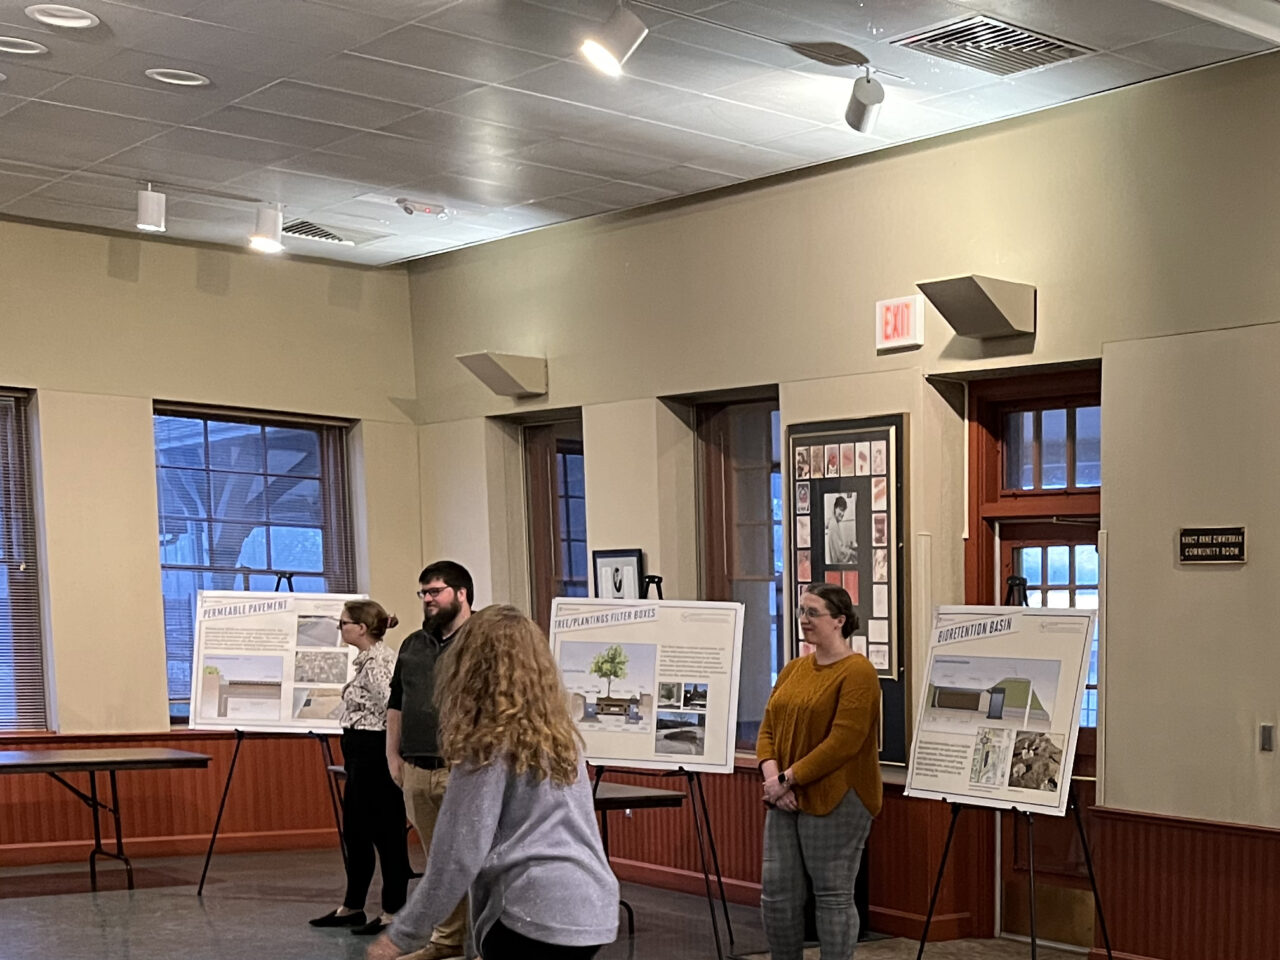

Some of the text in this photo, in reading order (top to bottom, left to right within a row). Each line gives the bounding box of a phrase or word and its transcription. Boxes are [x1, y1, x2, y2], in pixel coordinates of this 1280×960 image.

[883, 302, 912, 341] EXIT
[1185, 547, 1239, 555] COMMUNITY ROOM
[203, 599, 287, 618] PERMEABLE PAVEMENT
[554, 608, 656, 629] TREE/PLANTINGS FILTER BOXES
[937, 617, 1012, 643] BIORETENTION BASIN
